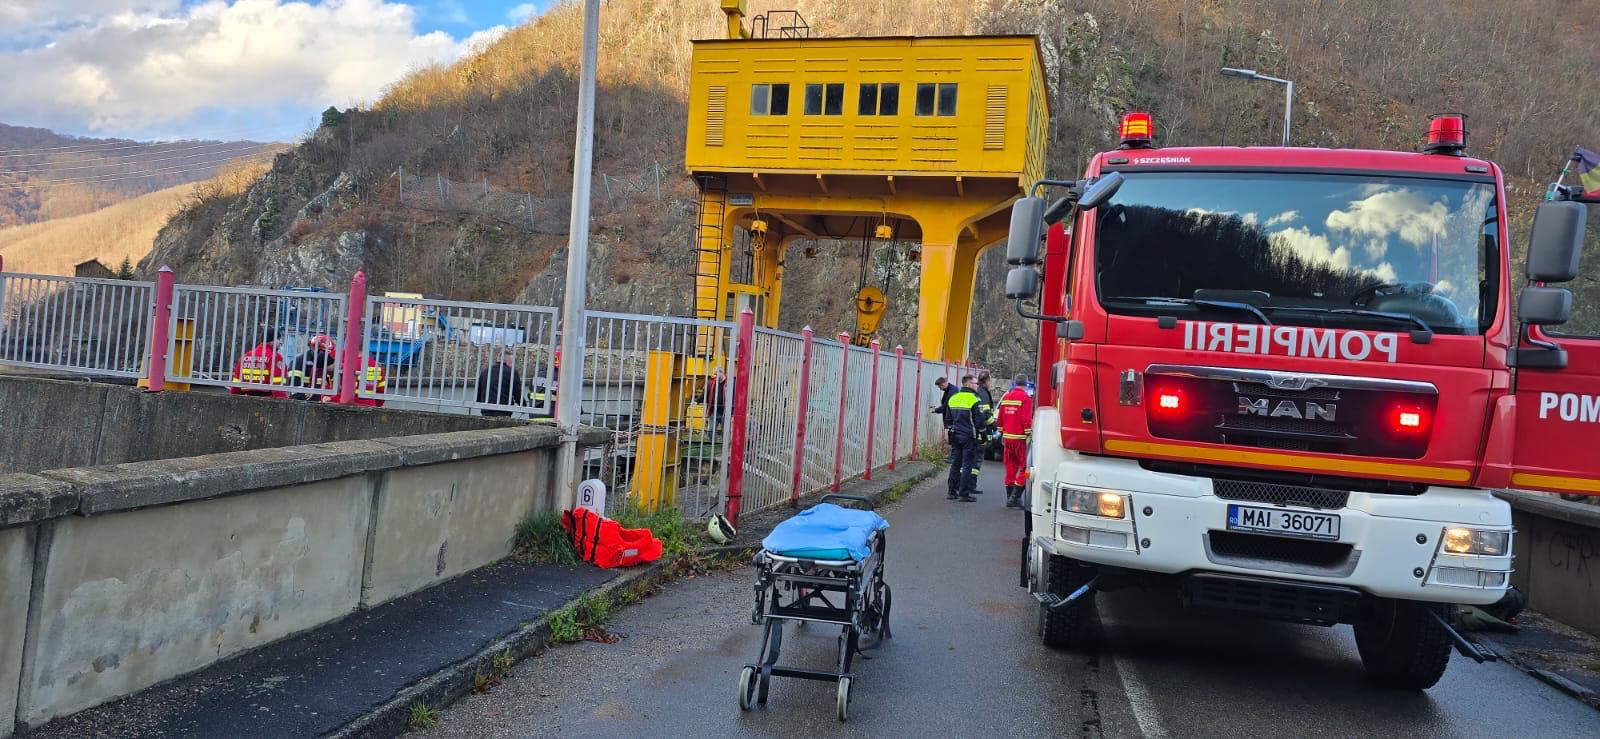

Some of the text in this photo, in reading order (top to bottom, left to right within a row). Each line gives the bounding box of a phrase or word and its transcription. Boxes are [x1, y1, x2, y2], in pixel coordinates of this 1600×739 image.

[1238, 396, 1337, 422] MAN
[1539, 391, 1600, 423] POM
[583, 488, 591, 503] 6
[1229, 516, 1238, 525] RO
[1242, 508, 1333, 534] MAI 36071
